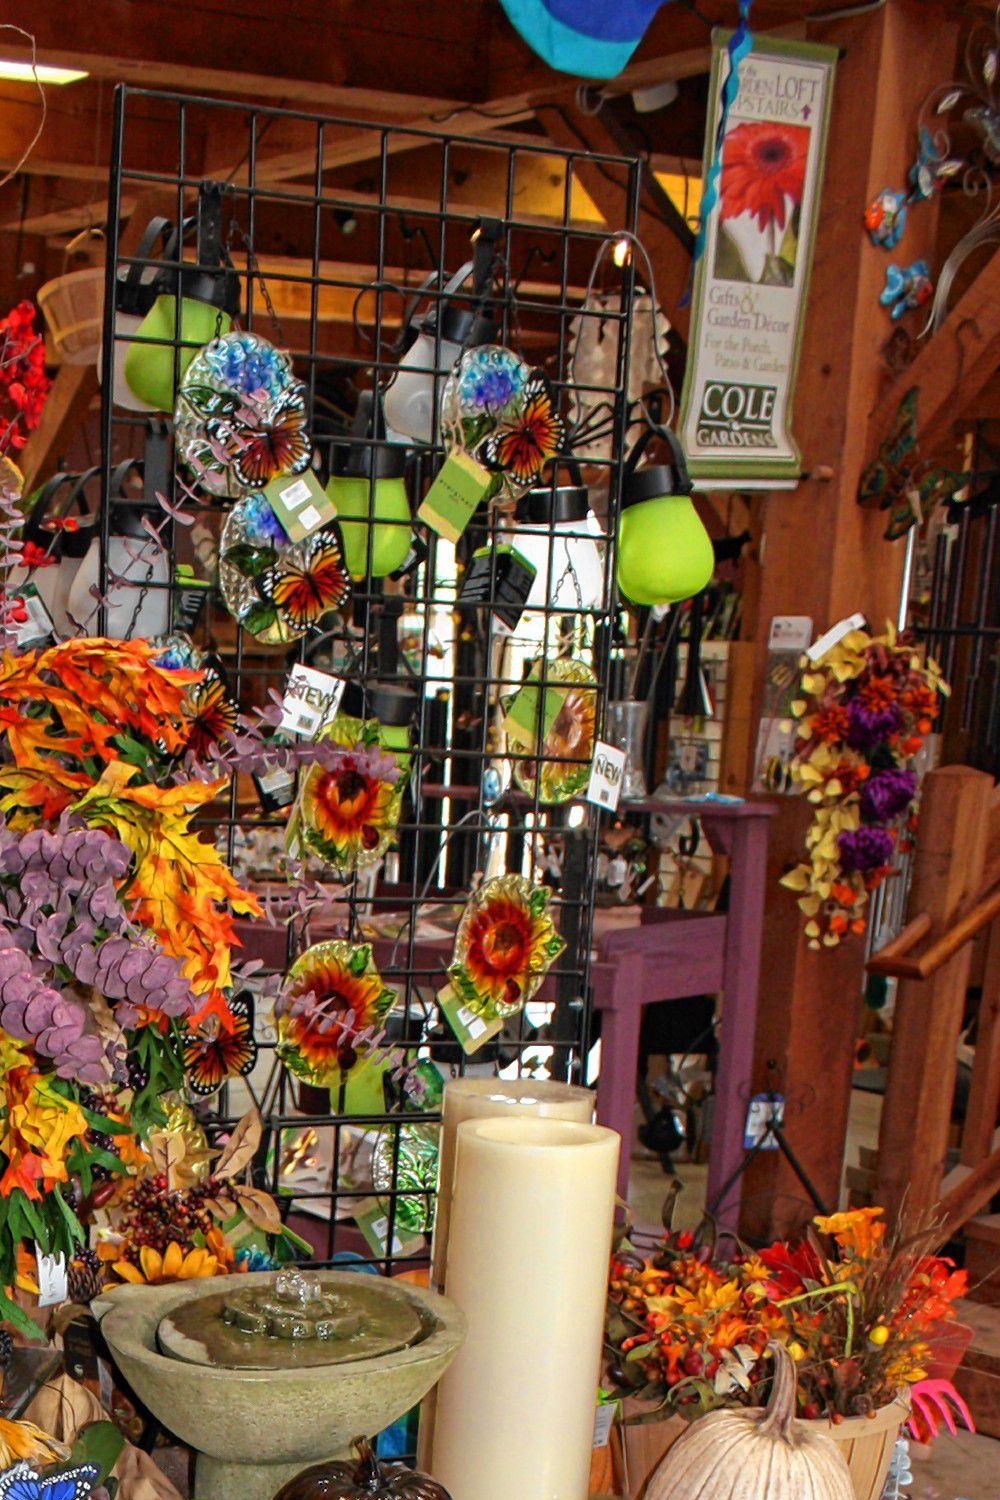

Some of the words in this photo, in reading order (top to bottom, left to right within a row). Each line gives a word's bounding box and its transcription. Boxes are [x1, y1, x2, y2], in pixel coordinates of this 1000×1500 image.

[774, 75, 819, 102] LOFT
[709, 286, 739, 306] Gifts
[740, 285, 760, 315] &
[707, 307, 751, 329] Garden
[752, 312, 791, 334] Décor
[702, 383, 777, 420] COLE
[697, 427, 777, 448] GARDENS
[593, 757, 623, 786] NEW
